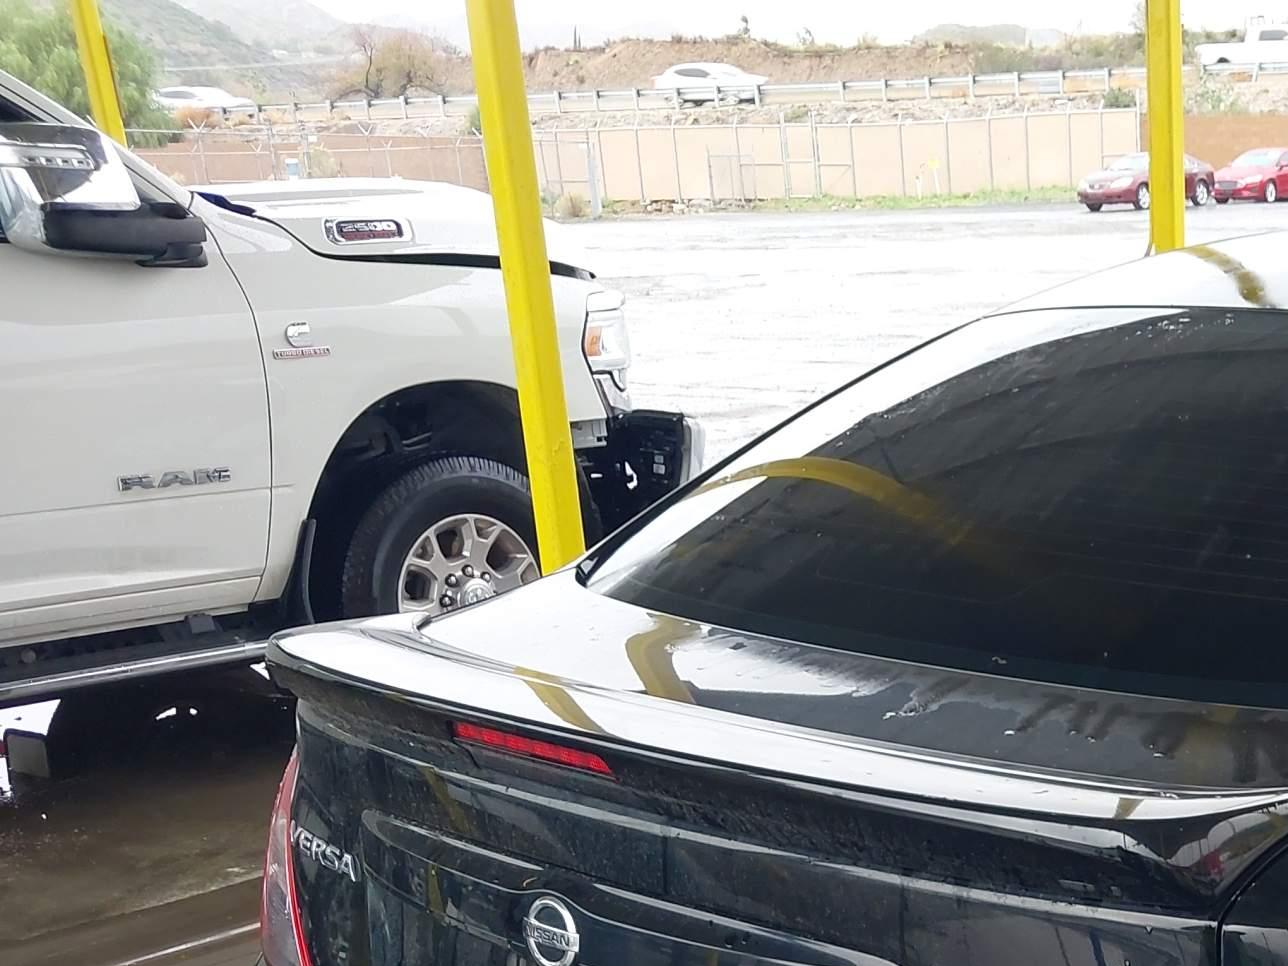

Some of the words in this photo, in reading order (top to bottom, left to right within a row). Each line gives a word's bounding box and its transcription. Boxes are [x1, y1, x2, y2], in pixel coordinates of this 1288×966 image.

[340, 221, 397, 232] 2500
[117, 466, 231, 492] RAM
[290, 820, 357, 882] VERSA
[526, 922, 569, 946] NISSAN
